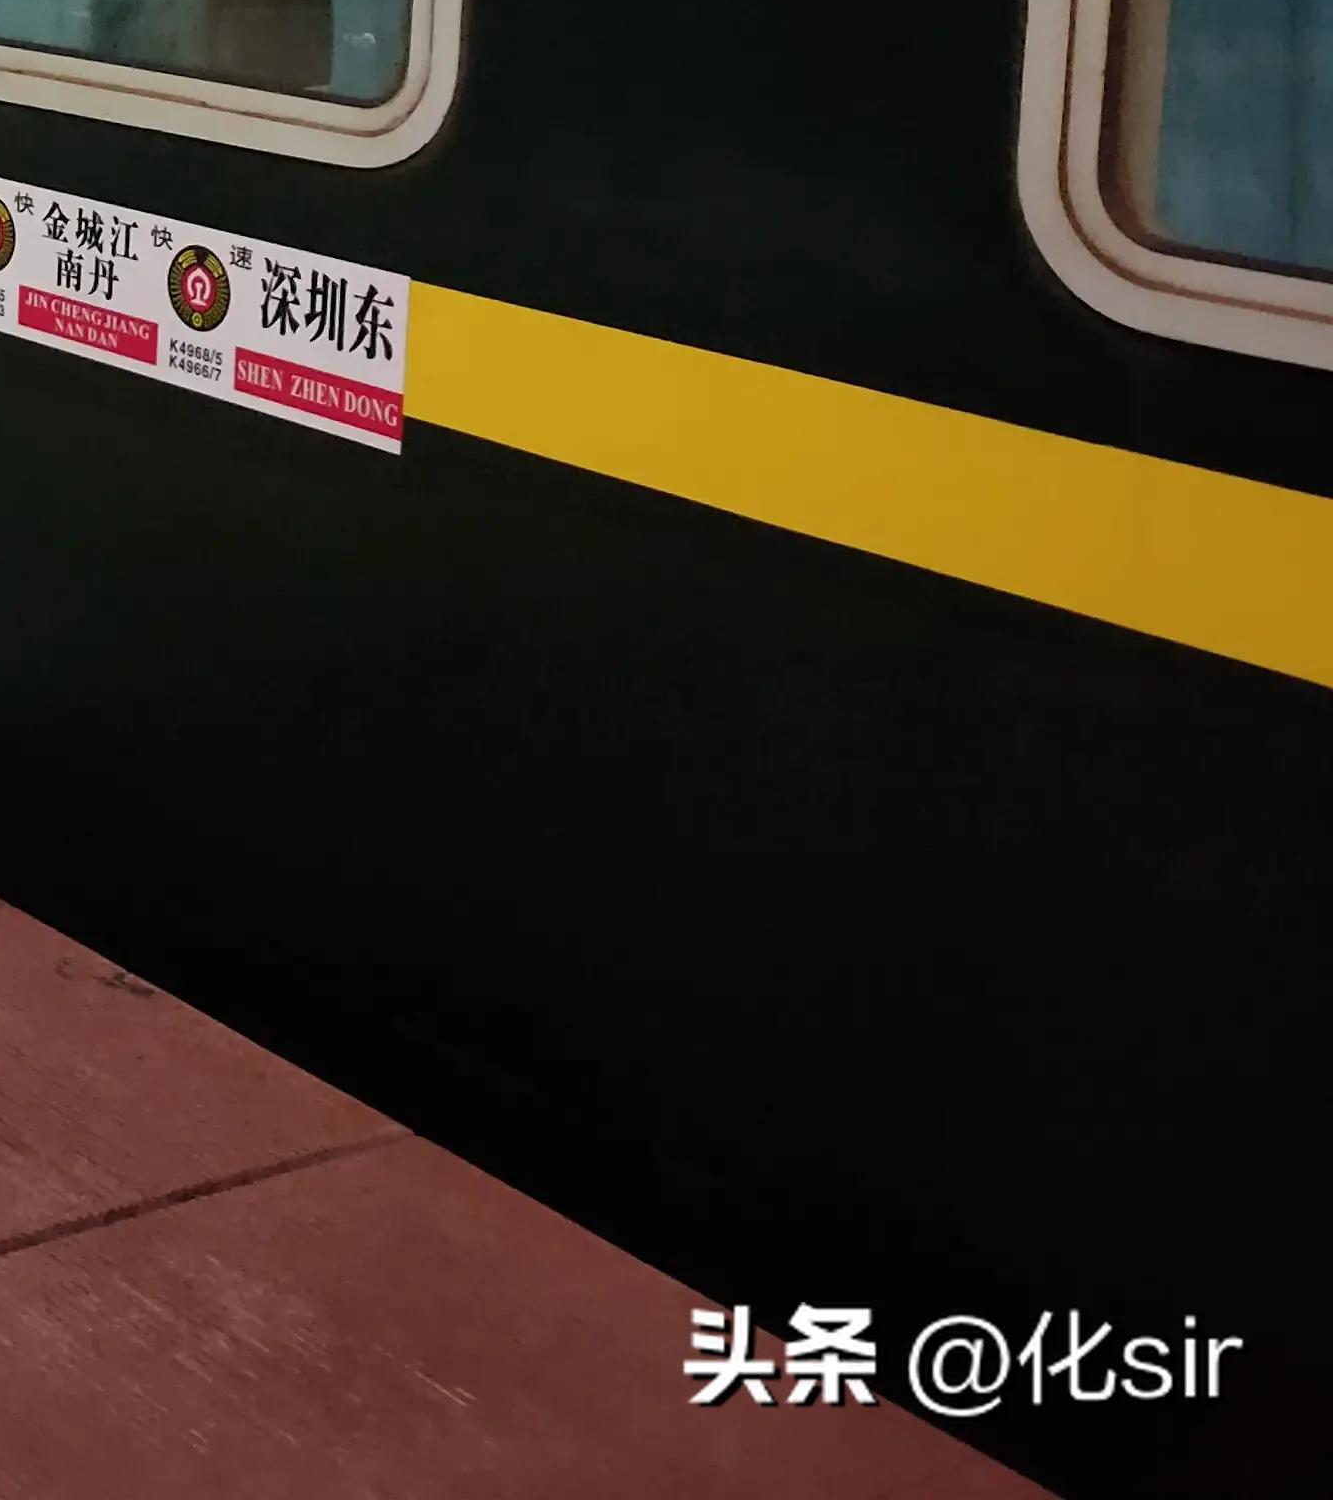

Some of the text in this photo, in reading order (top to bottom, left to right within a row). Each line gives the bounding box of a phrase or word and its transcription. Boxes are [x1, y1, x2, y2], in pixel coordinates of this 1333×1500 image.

[14, 191, 34, 216] 快
[42, 201, 139, 261] 金城江
[151, 224, 253, 270] 快 速
[56, 248, 119, 301] 南丹
[26, 292, 150, 340] JIN CHENG JIANG
[55, 317, 118, 348] NAN DAN
[260, 257, 395, 361] 深圳东
[169, 354, 222, 382] K4966/7
[170, 338, 223, 365] K4968/5
[237, 359, 399, 427] SHEN ZHEN DONG
